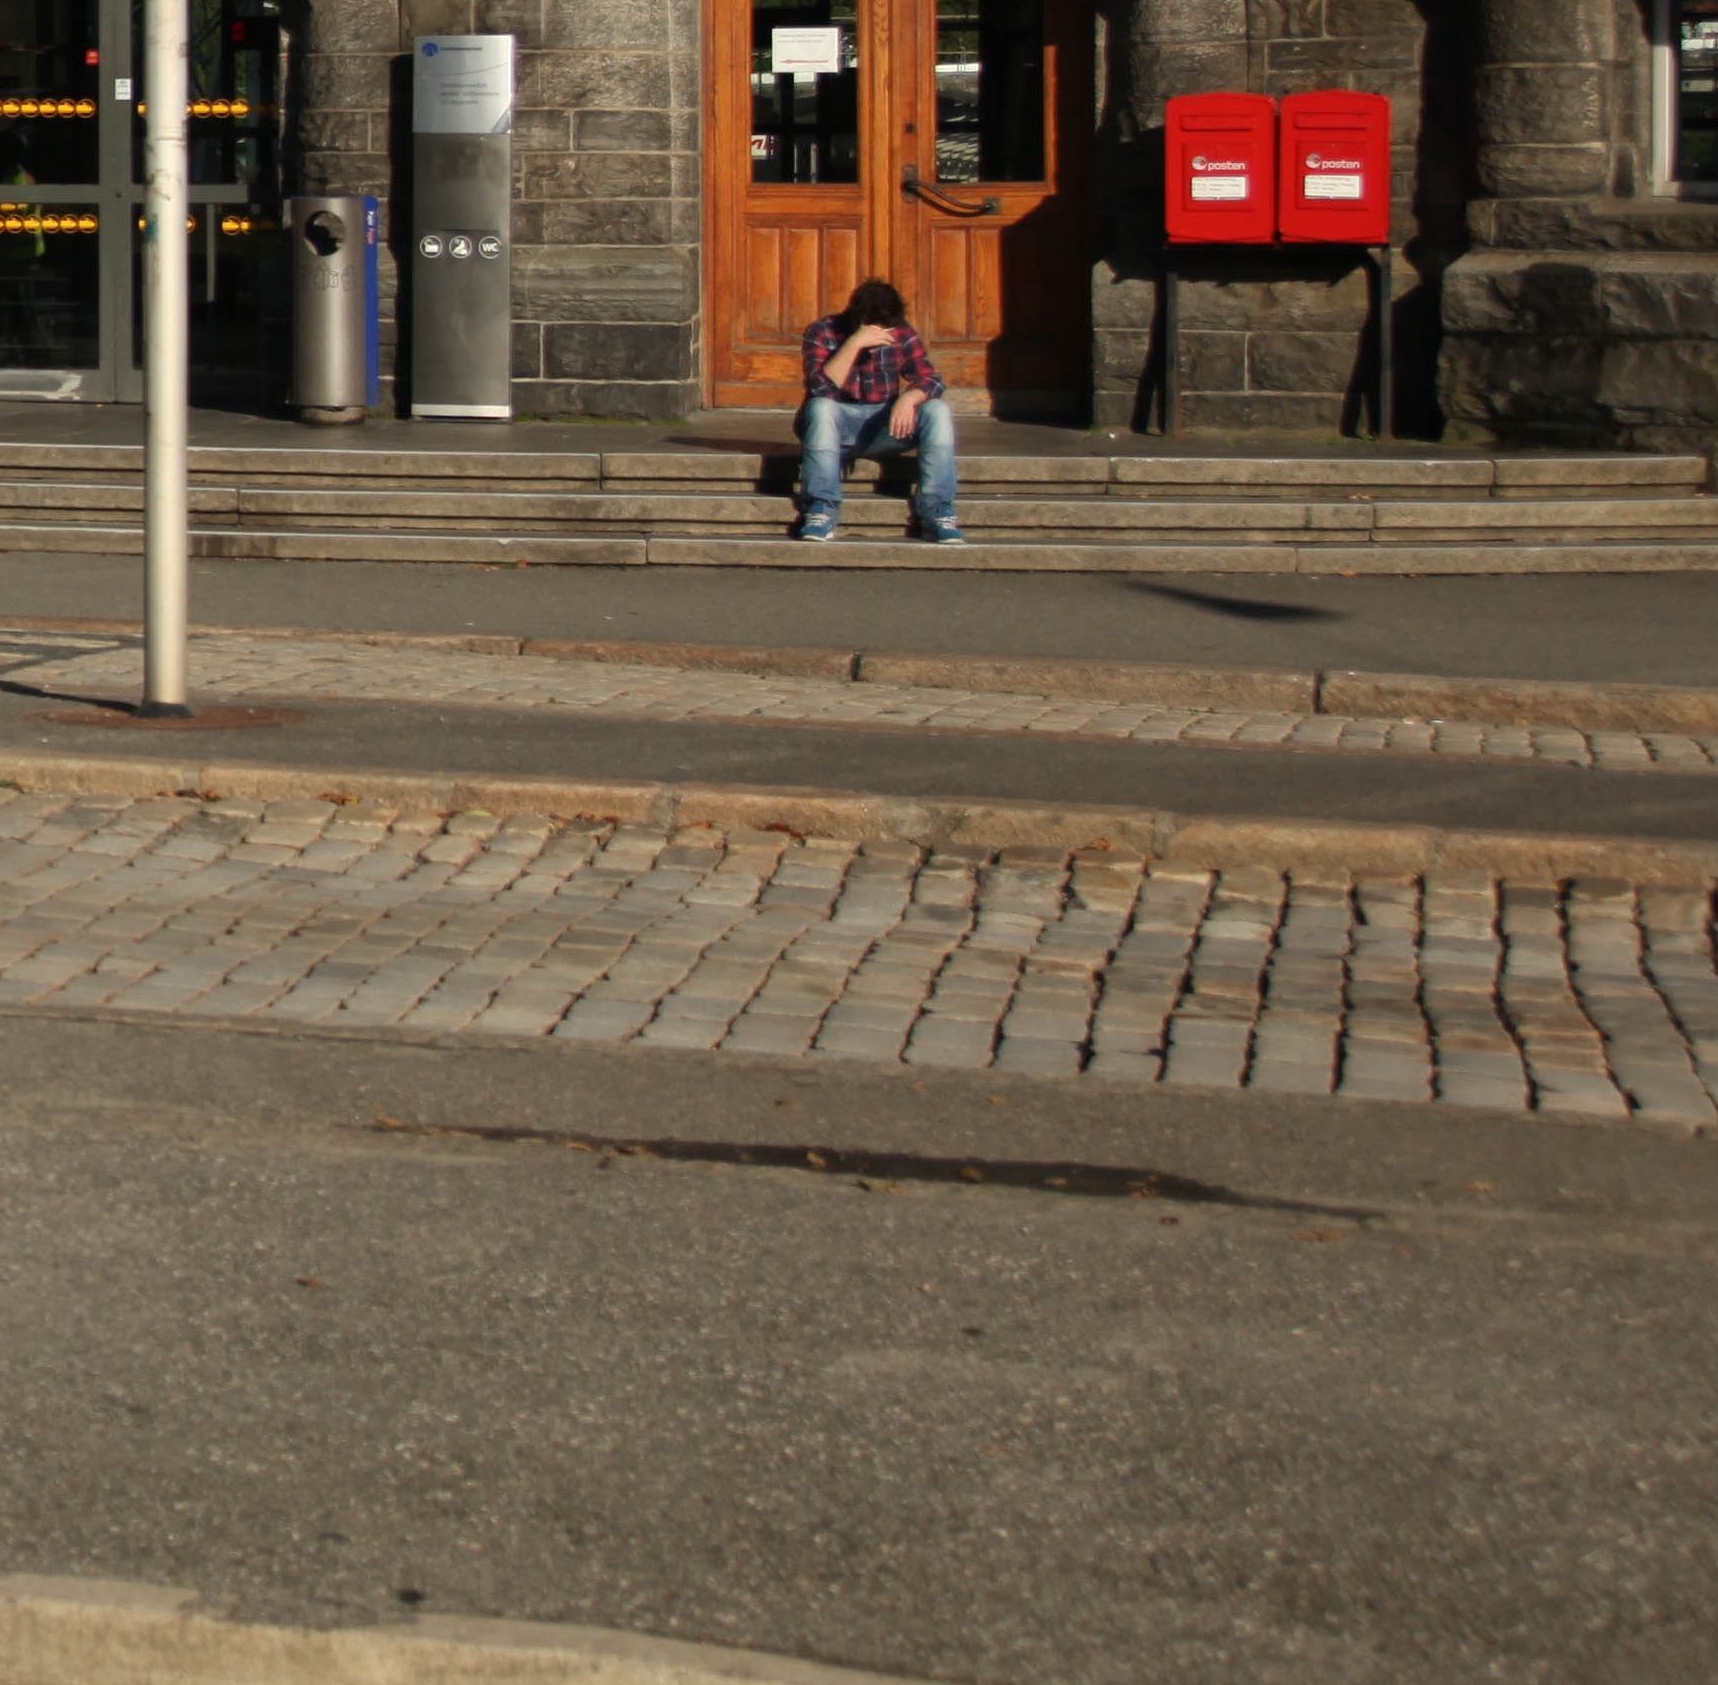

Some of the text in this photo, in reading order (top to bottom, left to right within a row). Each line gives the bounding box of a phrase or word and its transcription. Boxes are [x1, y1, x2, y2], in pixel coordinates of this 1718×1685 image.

[1208, 160, 1245, 171] posten
[1322, 159, 1360, 170] posten
[482, 243, 498, 252] WC
